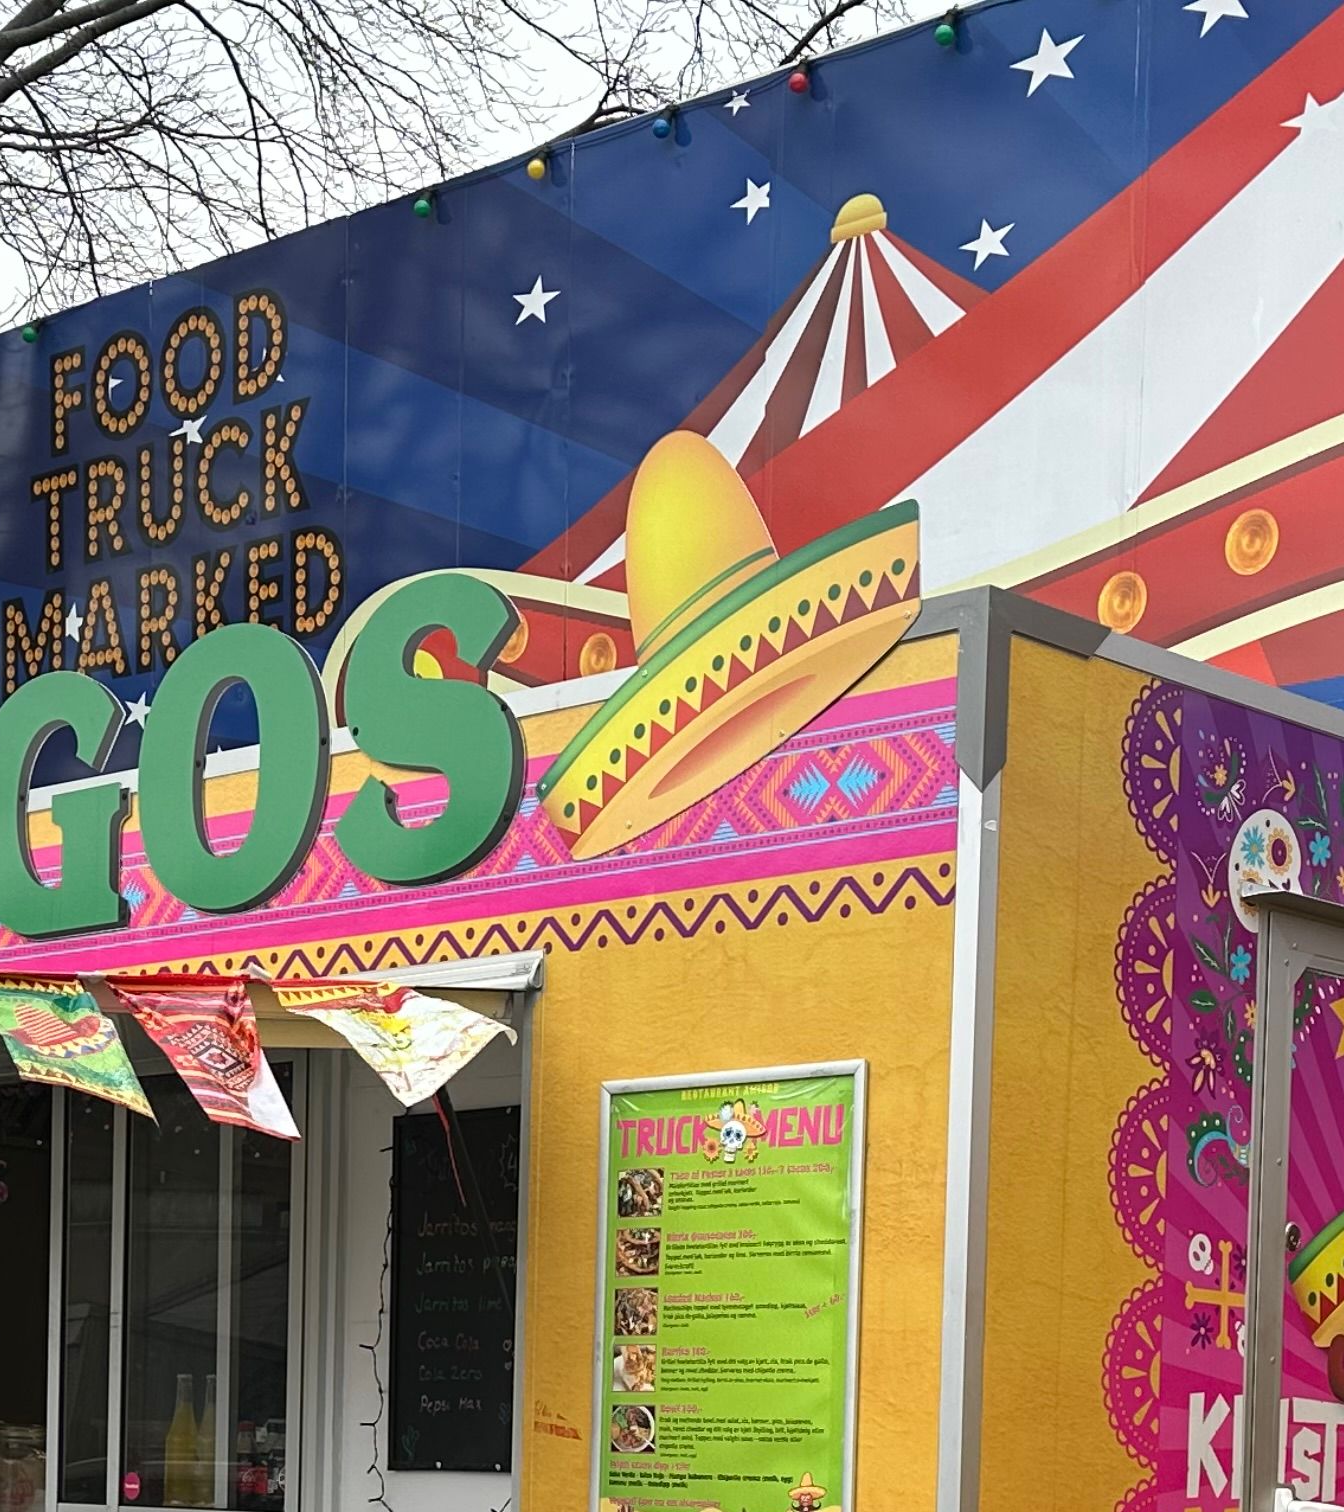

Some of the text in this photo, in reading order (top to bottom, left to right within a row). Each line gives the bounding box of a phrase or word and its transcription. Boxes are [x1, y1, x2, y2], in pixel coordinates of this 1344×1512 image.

[50, 288, 288, 457] FOOD
[30, 397, 312, 573] TRUCK
[2, 525, 345, 704] MARKED
[616, 1103, 845, 1159] TRUCK MENU
